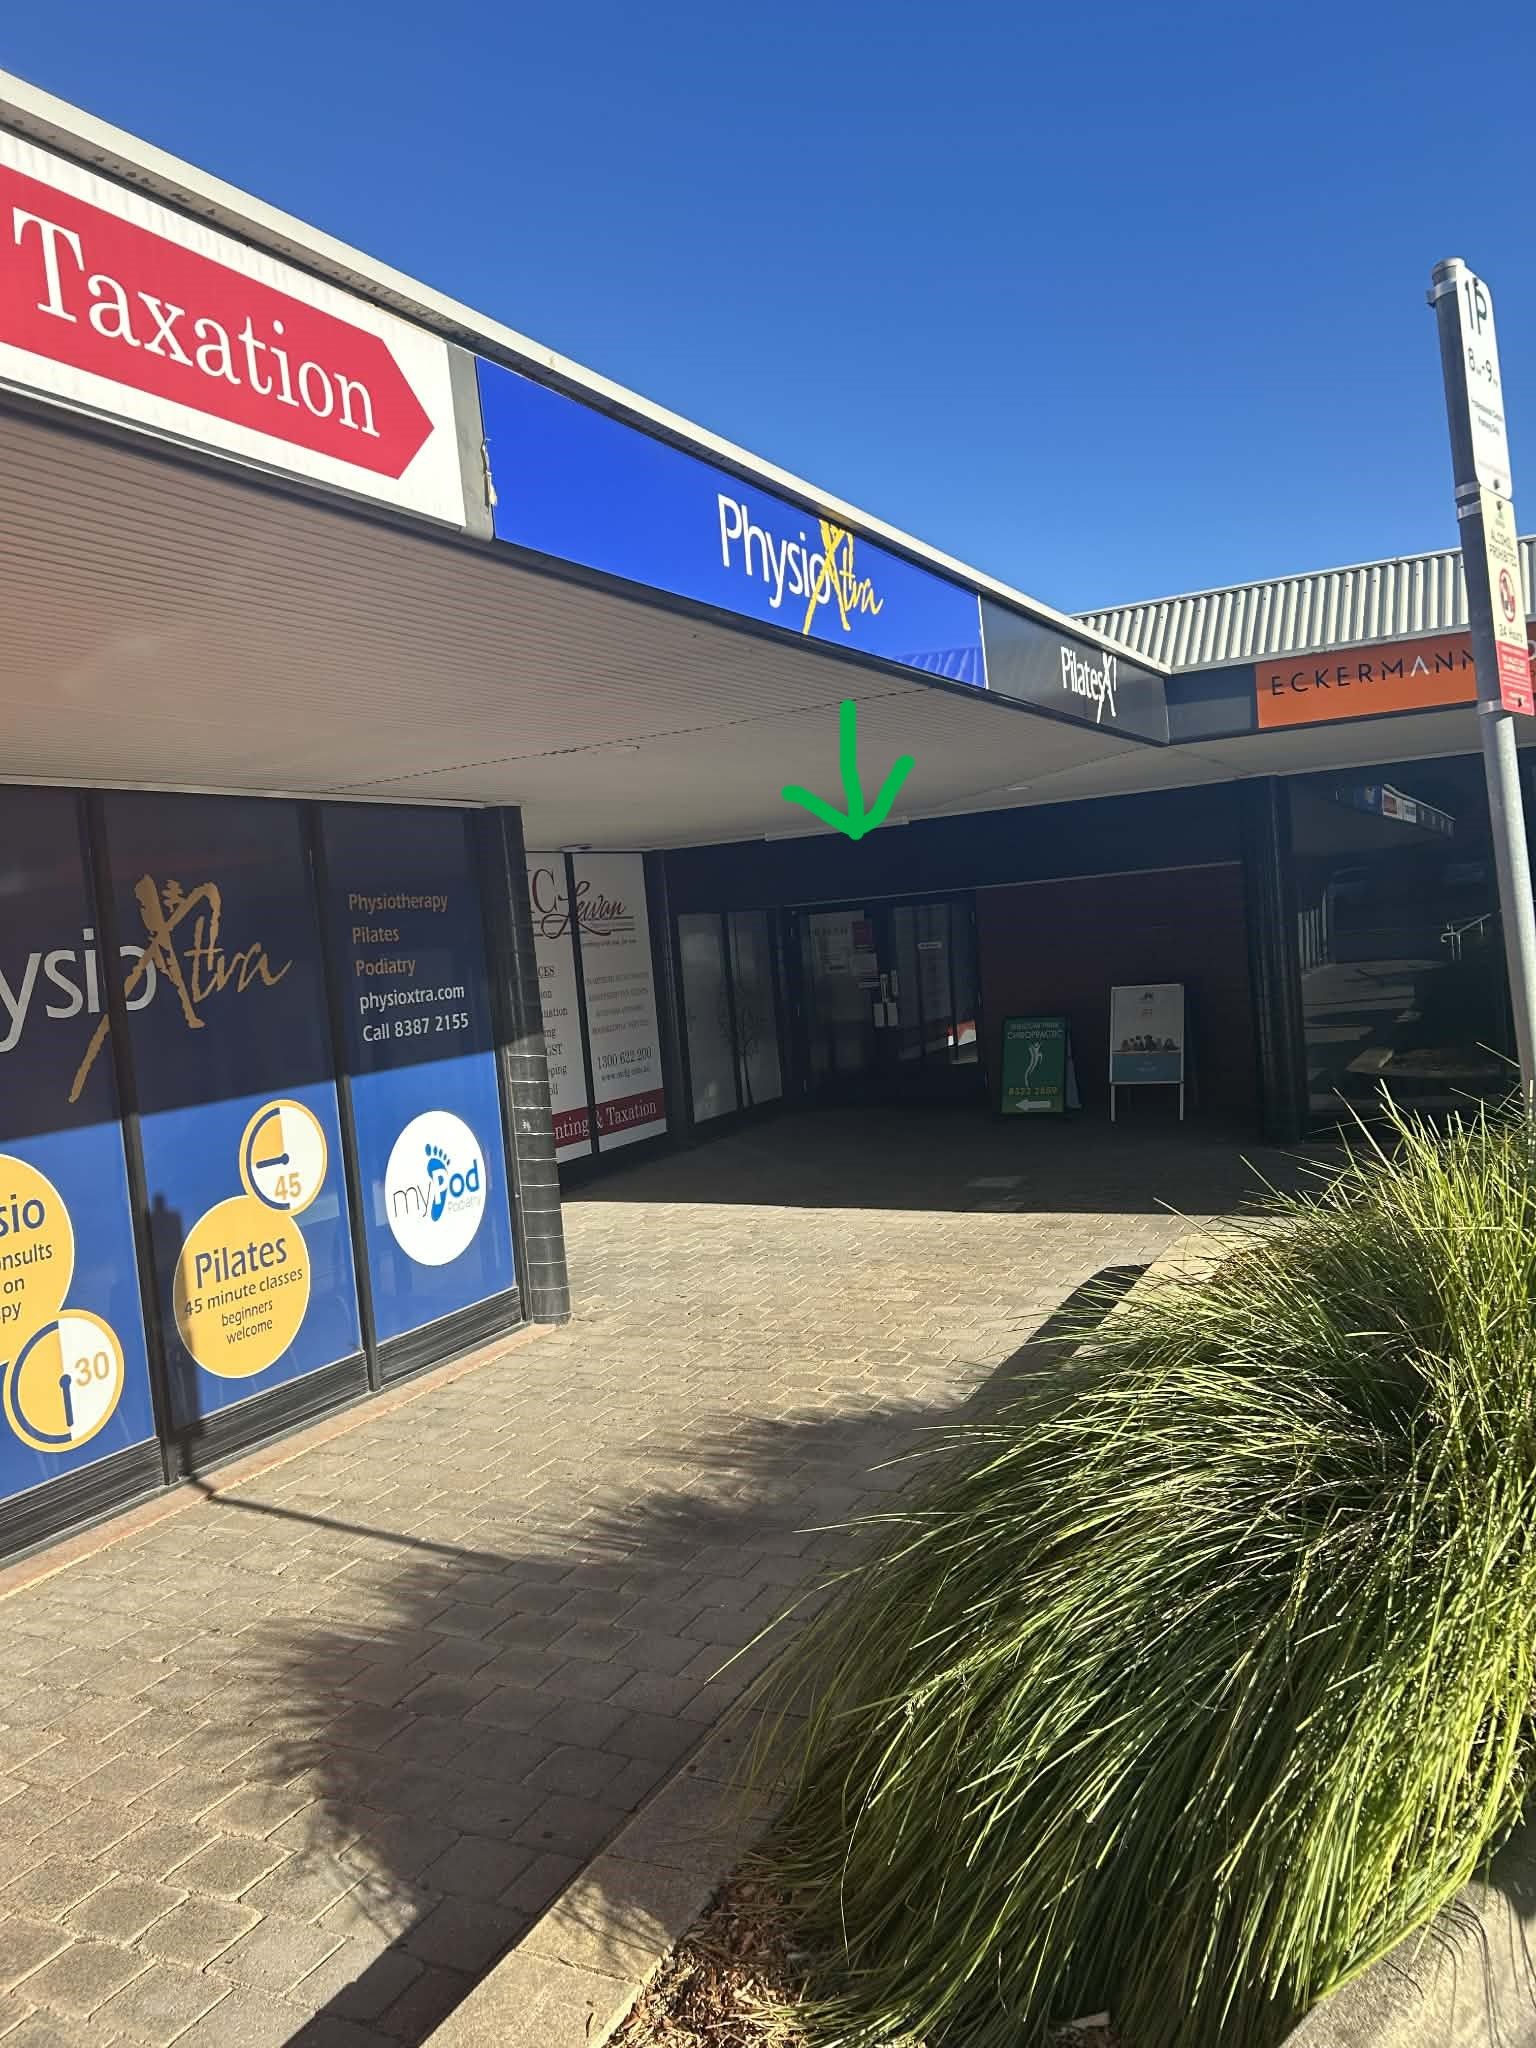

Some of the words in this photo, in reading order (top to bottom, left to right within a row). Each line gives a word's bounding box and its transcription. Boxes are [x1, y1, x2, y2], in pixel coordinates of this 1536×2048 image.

[1464, 277, 1487, 335] 1P
[12, 206, 380, 438] Taxation
[717, 494, 884, 635] PhysioXtra
[348, 893, 448, 915] Physiotherapy
[352, 926, 400, 944] Pilates
[355, 957, 416, 976] Podiatry
[359, 985, 465, 1014] physioxtra.com
[362, 1024, 390, 1042] Call
[394, 1018, 430, 1037] 8387
[435, 1012, 469, 1032] 2155
[606, 1099, 657, 1126] Taxation
[274, 1172, 302, 1200] 45
[0, 1244, 53, 1271] nsults
[195, 1237, 287, 1288] Pilates
[3, 1278, 25, 1294] on
[184, 1298, 202, 1317] 45
[207, 1282, 257, 1310] minute
[260, 1268, 303, 1293] classes
[221, 1299, 273, 1327] beginners
[226, 1318, 273, 1345] welcome
[74, 1351, 110, 1387] 30
